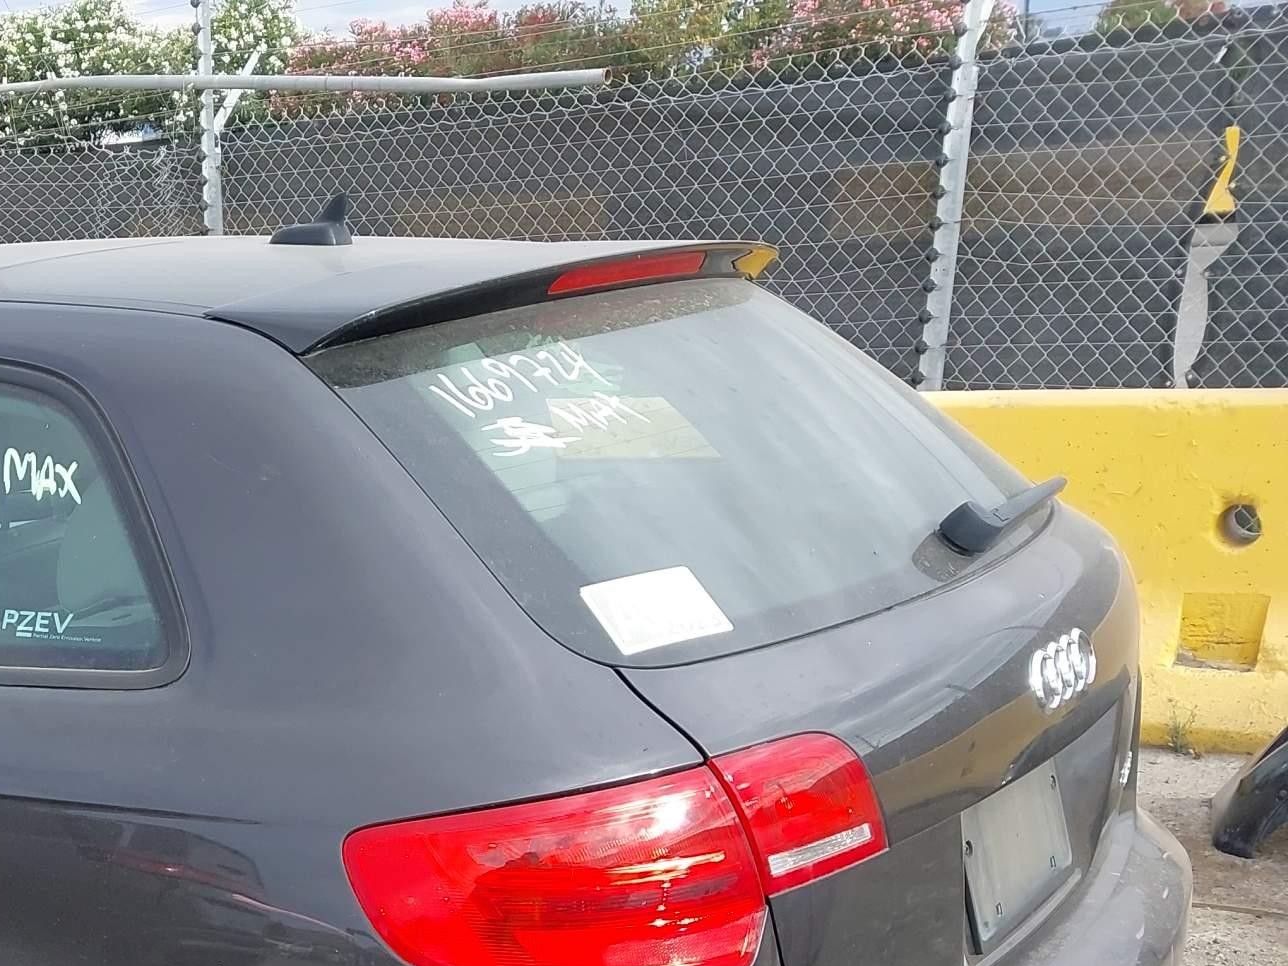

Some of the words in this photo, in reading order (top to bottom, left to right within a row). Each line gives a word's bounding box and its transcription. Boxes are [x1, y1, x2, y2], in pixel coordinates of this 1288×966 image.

[428, 341, 613, 418] 1669724
[3, 447, 82, 505] MAX
[1, 609, 74, 634] PZEV
